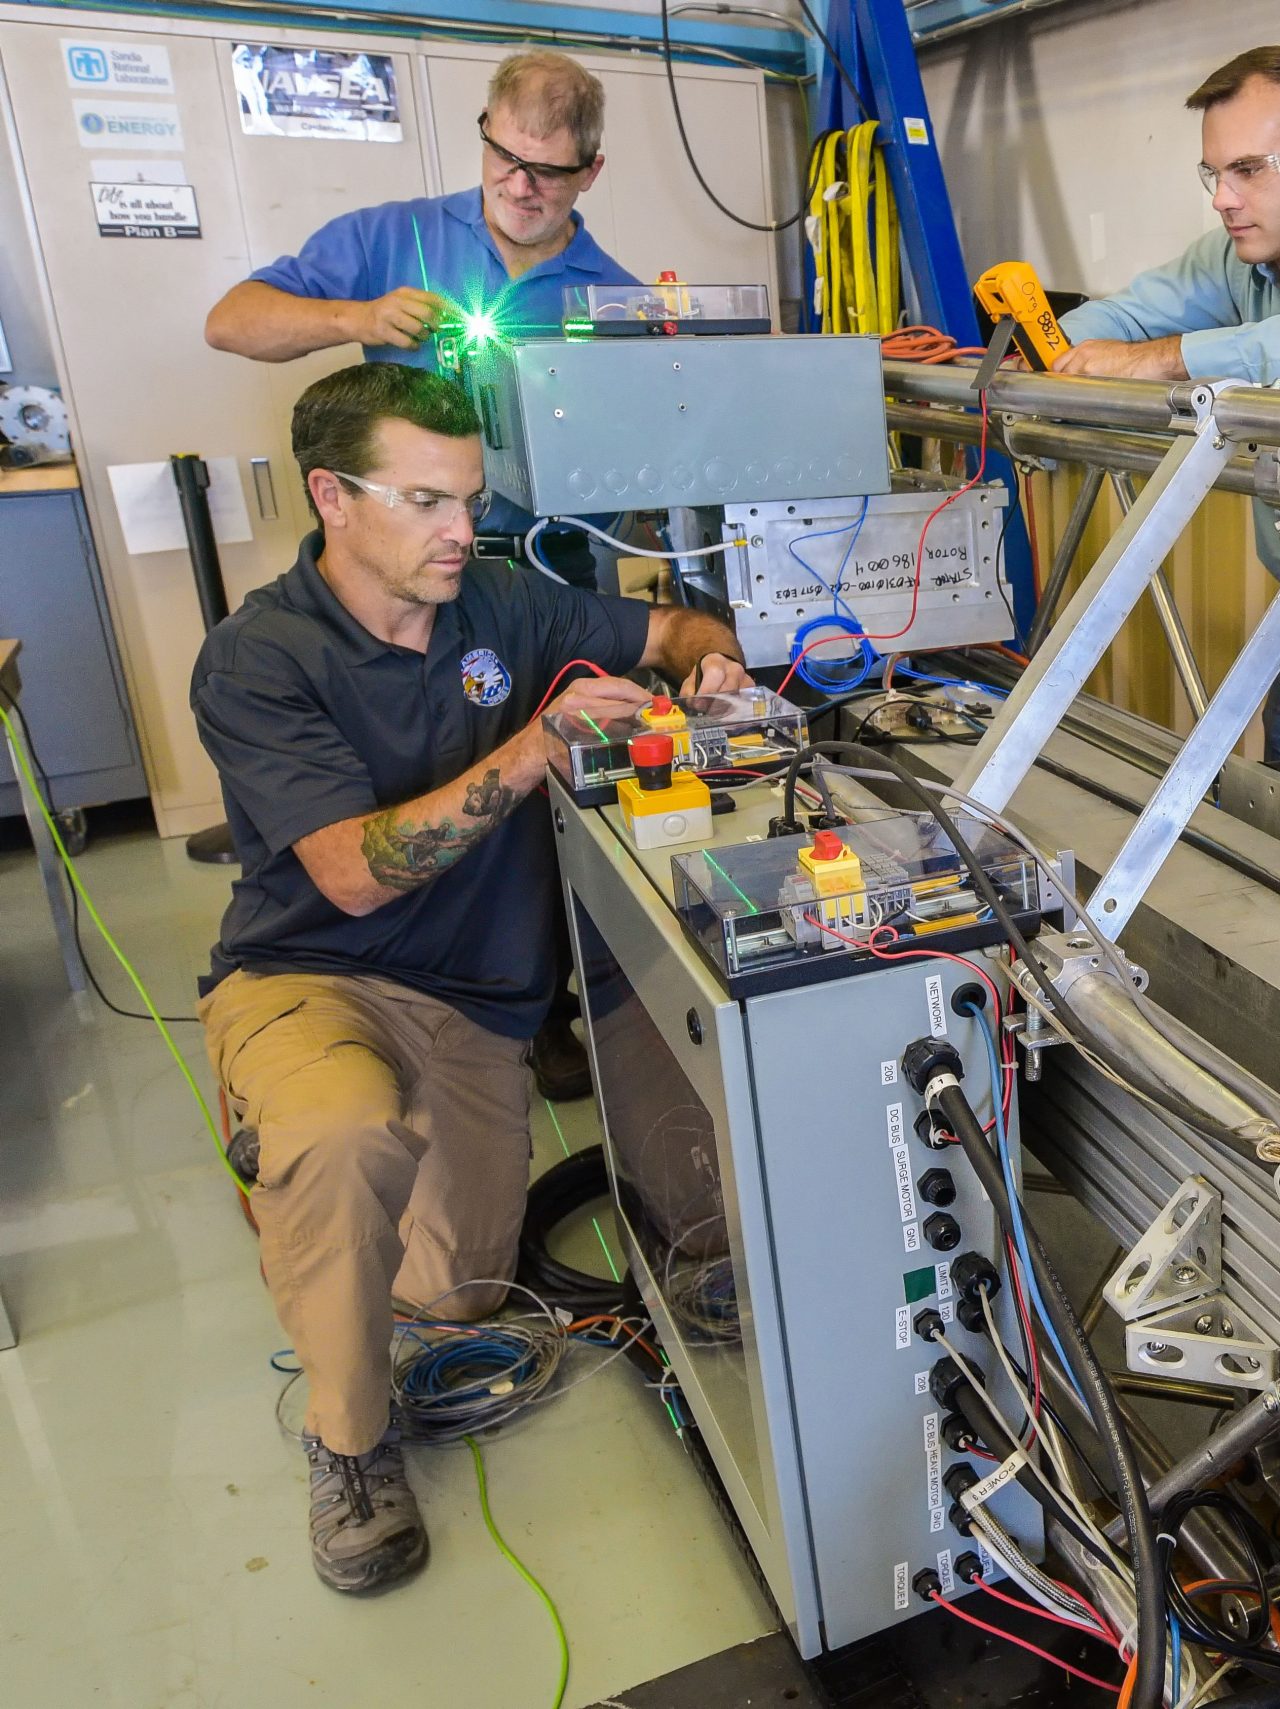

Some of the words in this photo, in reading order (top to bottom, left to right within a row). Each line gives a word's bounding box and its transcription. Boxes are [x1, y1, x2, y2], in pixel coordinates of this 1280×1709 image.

[111, 50, 143, 62] Sandia
[112, 61, 150, 73] National
[114, 73, 169, 86] Laboratories
[107, 120, 177, 136] ENERGY
[130, 200, 142, 209] all
[145, 200, 173, 210] about
[109, 211, 130, 221] how
[134, 213, 152, 224] you
[153, 212, 188, 222] handle
[124, 225, 161, 237] Plan
[163, 227, 177, 238] B
[1021, 281, 1038, 313] Org
[1037, 311, 1060, 351] 8822
[925, 547, 967, 560] ROTOR
[929, 981, 942, 1030] NETWORK
[884, 1065, 893, 1082] 208
[889, 1109, 898, 1123] DC
[891, 1123, 900, 1144] BUS
[896, 1150, 908, 1183] SURGE
[901, 1183, 913, 1218] MOTOR
[906, 1228, 917, 1248] GND
[937, 1265, 948, 1287] LIMIT
[941, 1306, 950, 1321] 120
[898, 1310, 907, 1344] E-STOP
[917, 1376, 926, 1392] 208
[1094, 1379, 1110, 1410] RESISTANT
[926, 1418, 935, 1431] DC
[927, 1432, 936, 1448] BUS
[929, 1449, 938, 1476] HEAVE
[979, 1462, 1015, 1496] POWER
[930, 1477, 939, 1505] MOTOR
[933, 1511, 942, 1530] GND
[938, 1553, 947, 1584] TORQUE
